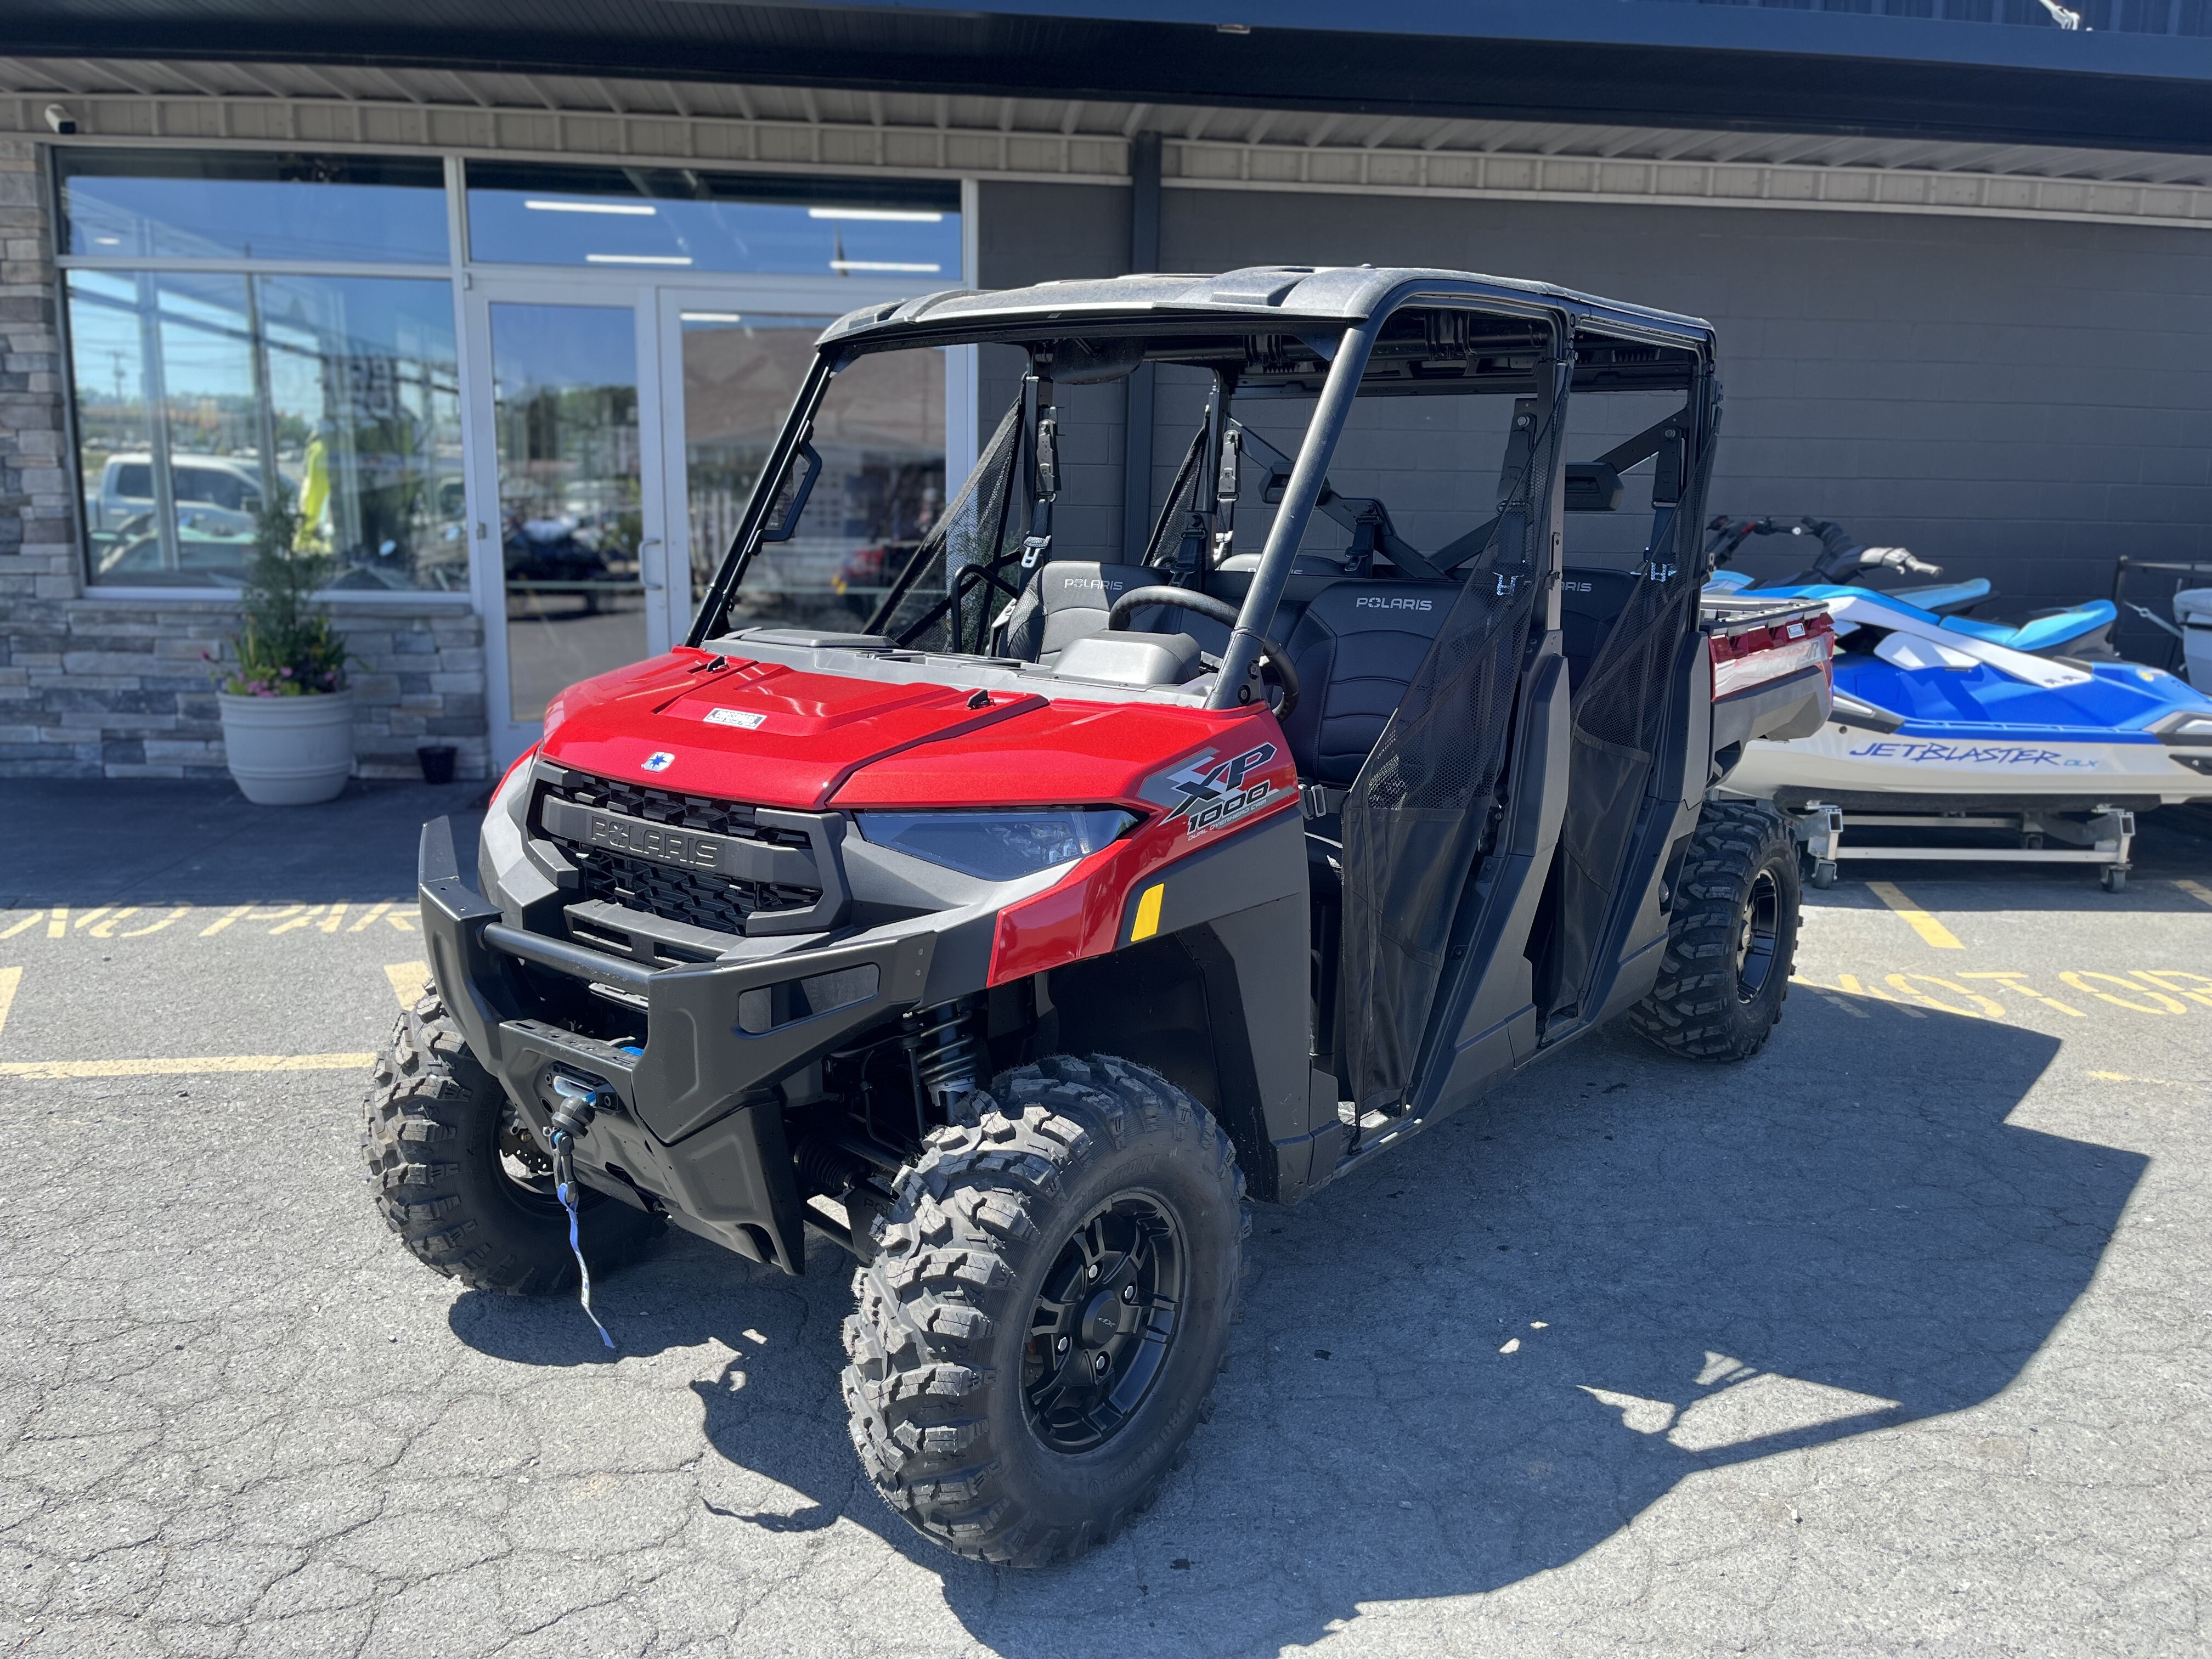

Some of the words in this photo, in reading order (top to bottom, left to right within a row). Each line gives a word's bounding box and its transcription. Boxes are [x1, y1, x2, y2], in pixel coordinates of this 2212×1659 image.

[1064, 579, 1124, 591] POLARIS
[1356, 597, 1432, 611] POLARIS
[1849, 742, 2062, 766] JETBLASTER
[1156, 742, 1277, 827] XP
[1187, 779, 1270, 836] 1000
[1187, 829, 1208, 842] DUAL
[1209, 809, 1250, 831] OVERHEAD
[1251, 799, 1267, 811] CAM
[591, 816, 718, 867] POLARIS
